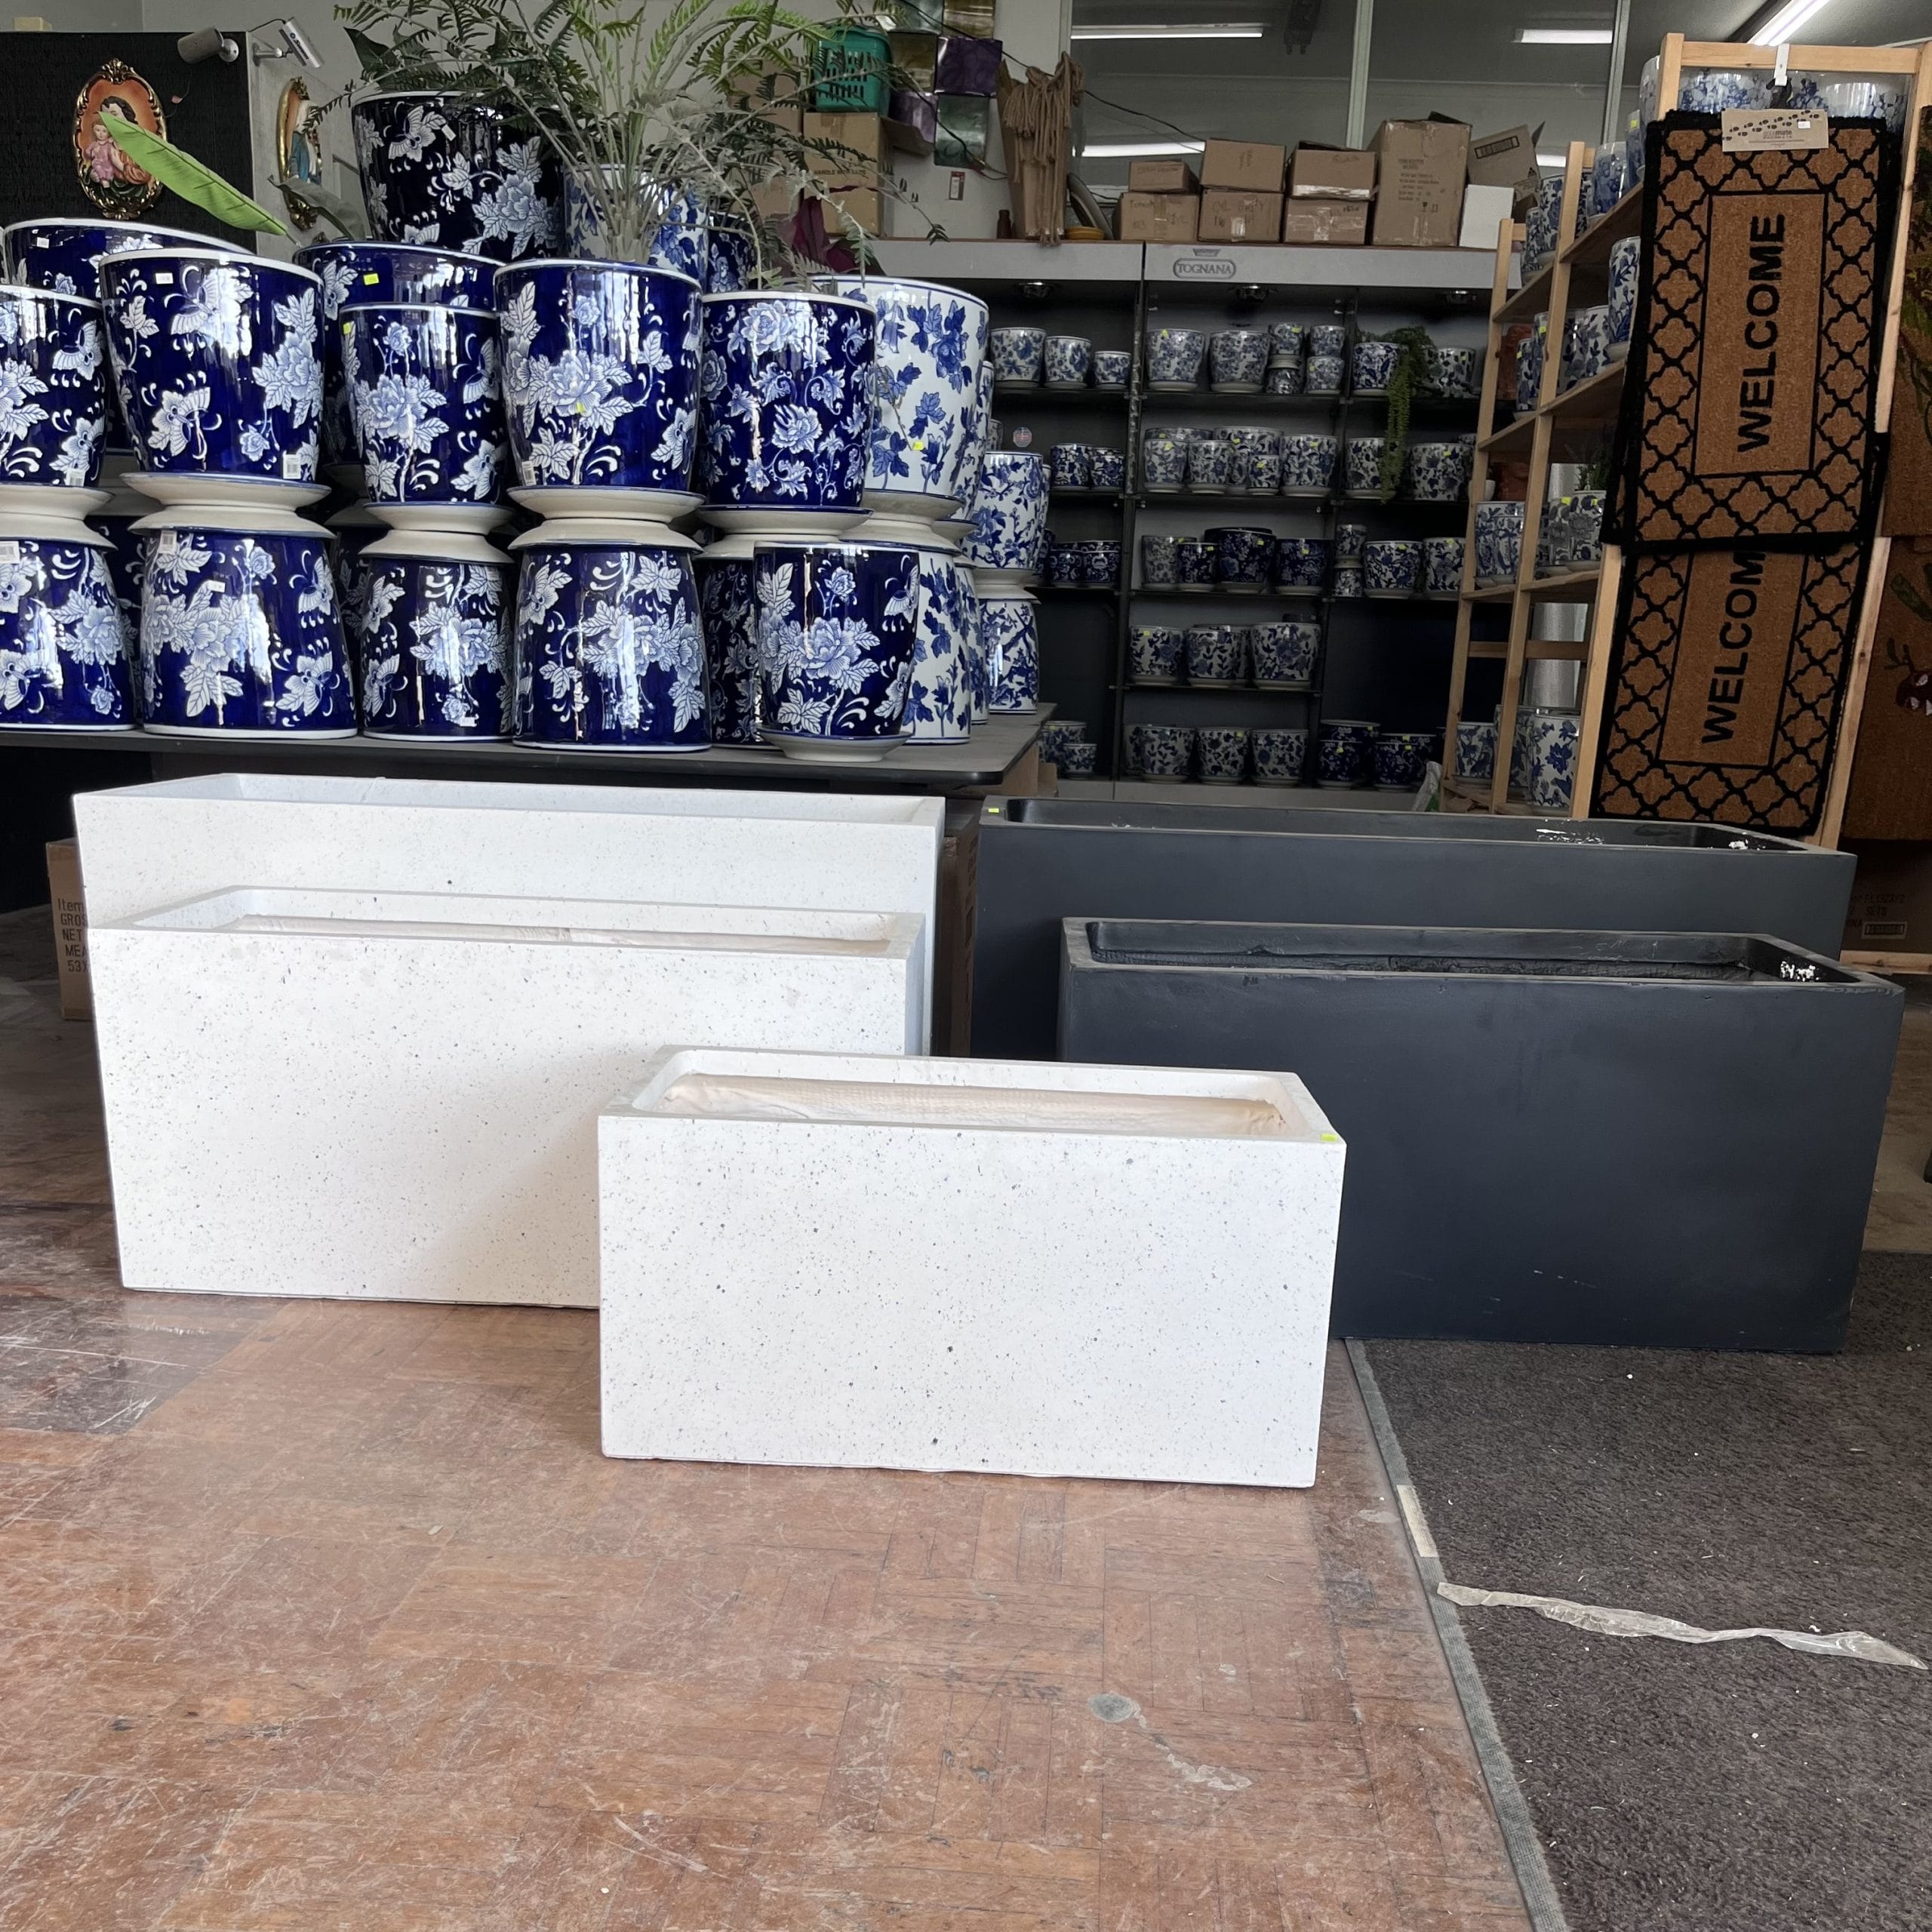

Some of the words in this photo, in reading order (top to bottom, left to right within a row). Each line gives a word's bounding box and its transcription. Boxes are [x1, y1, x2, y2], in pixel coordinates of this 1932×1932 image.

[1177, 263, 1232, 274] TOGNANA
[1737, 214, 1785, 453] WELCOME
[1702, 551, 1766, 743] WELCOM
[62, 929, 82, 942] NET
